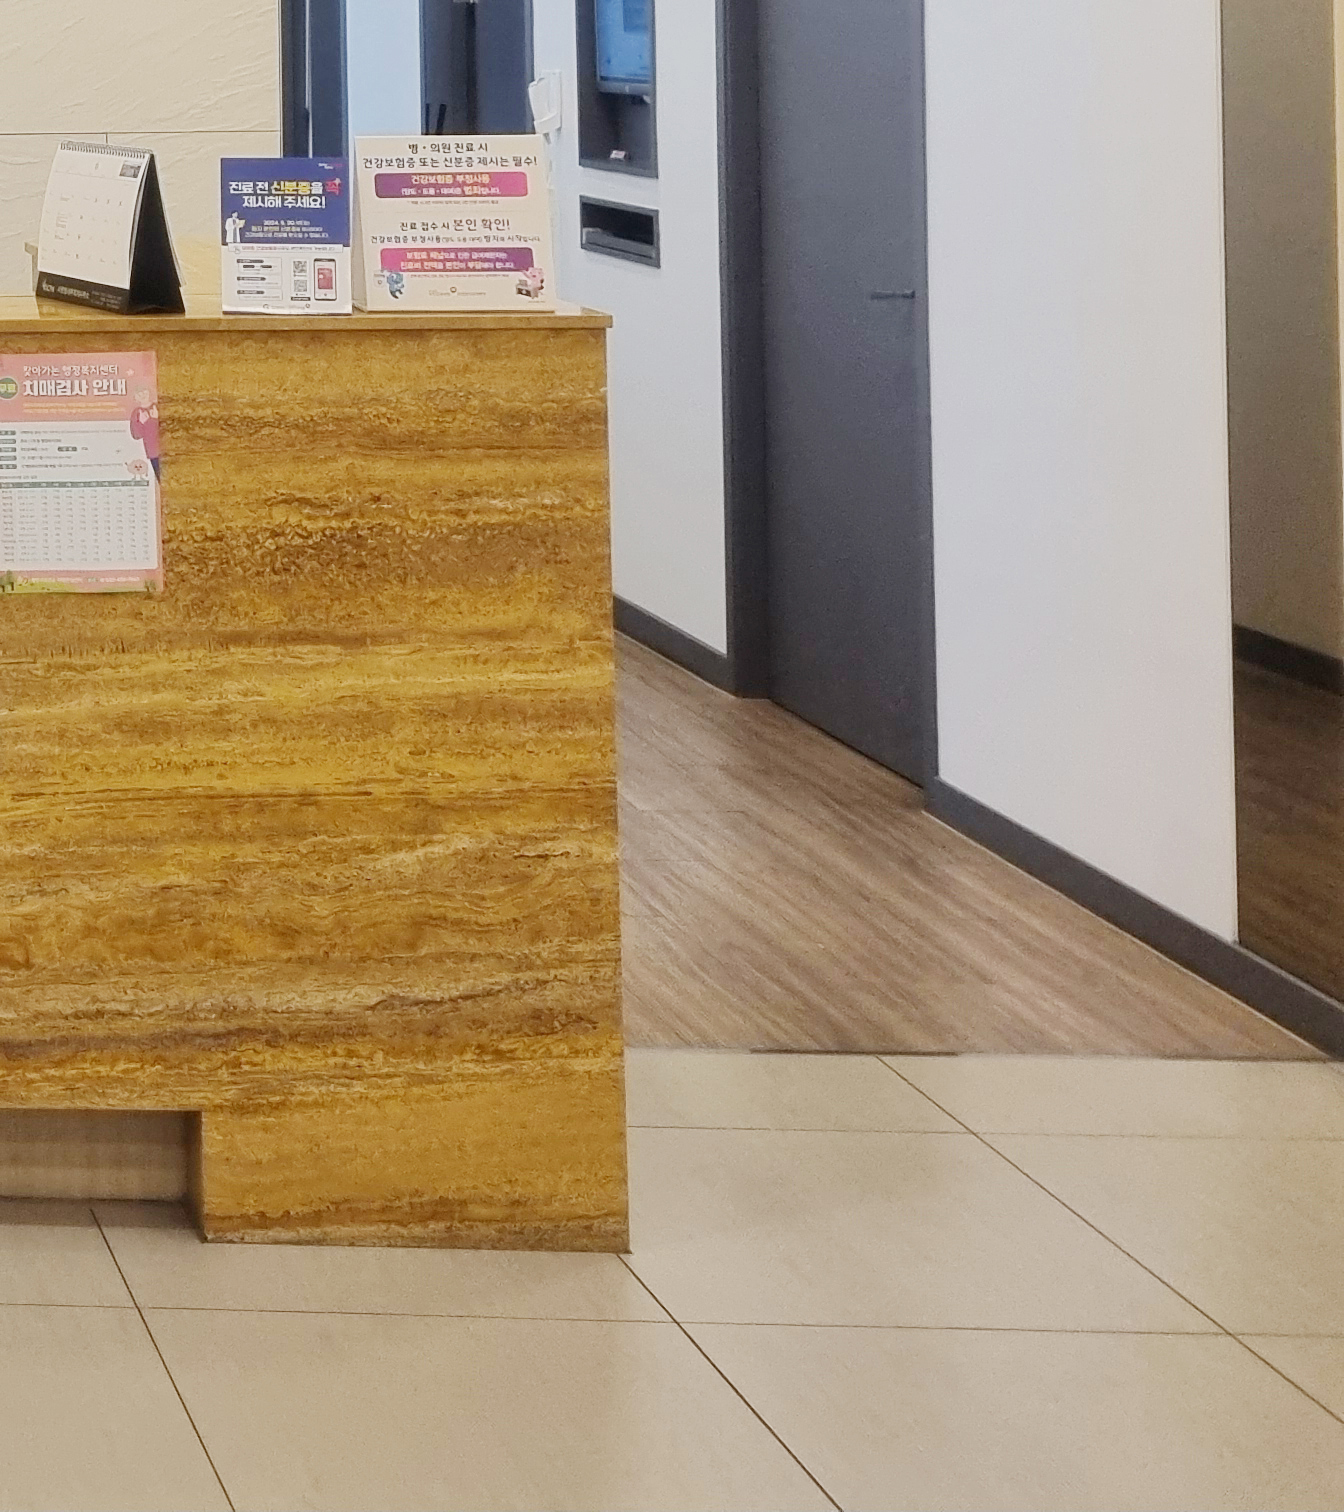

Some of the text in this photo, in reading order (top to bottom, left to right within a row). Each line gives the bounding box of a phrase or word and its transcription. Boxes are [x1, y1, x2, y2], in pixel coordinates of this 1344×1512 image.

[454, 142, 476, 153] 진료
[478, 142, 489, 152] 시
[363, 156, 538, 170] 건강보험증 또는 신분증 제시는 필수!
[229, 181, 254, 194] 진료
[256, 181, 269, 194] 전
[271, 180, 323, 196] 신분증을
[242, 195, 326, 209] 제시해 주세요!
[453, 219, 477, 232] 본인
[480, 218, 510, 231] 확인!
[23, 379, 127, 397] 치매검사 안내
